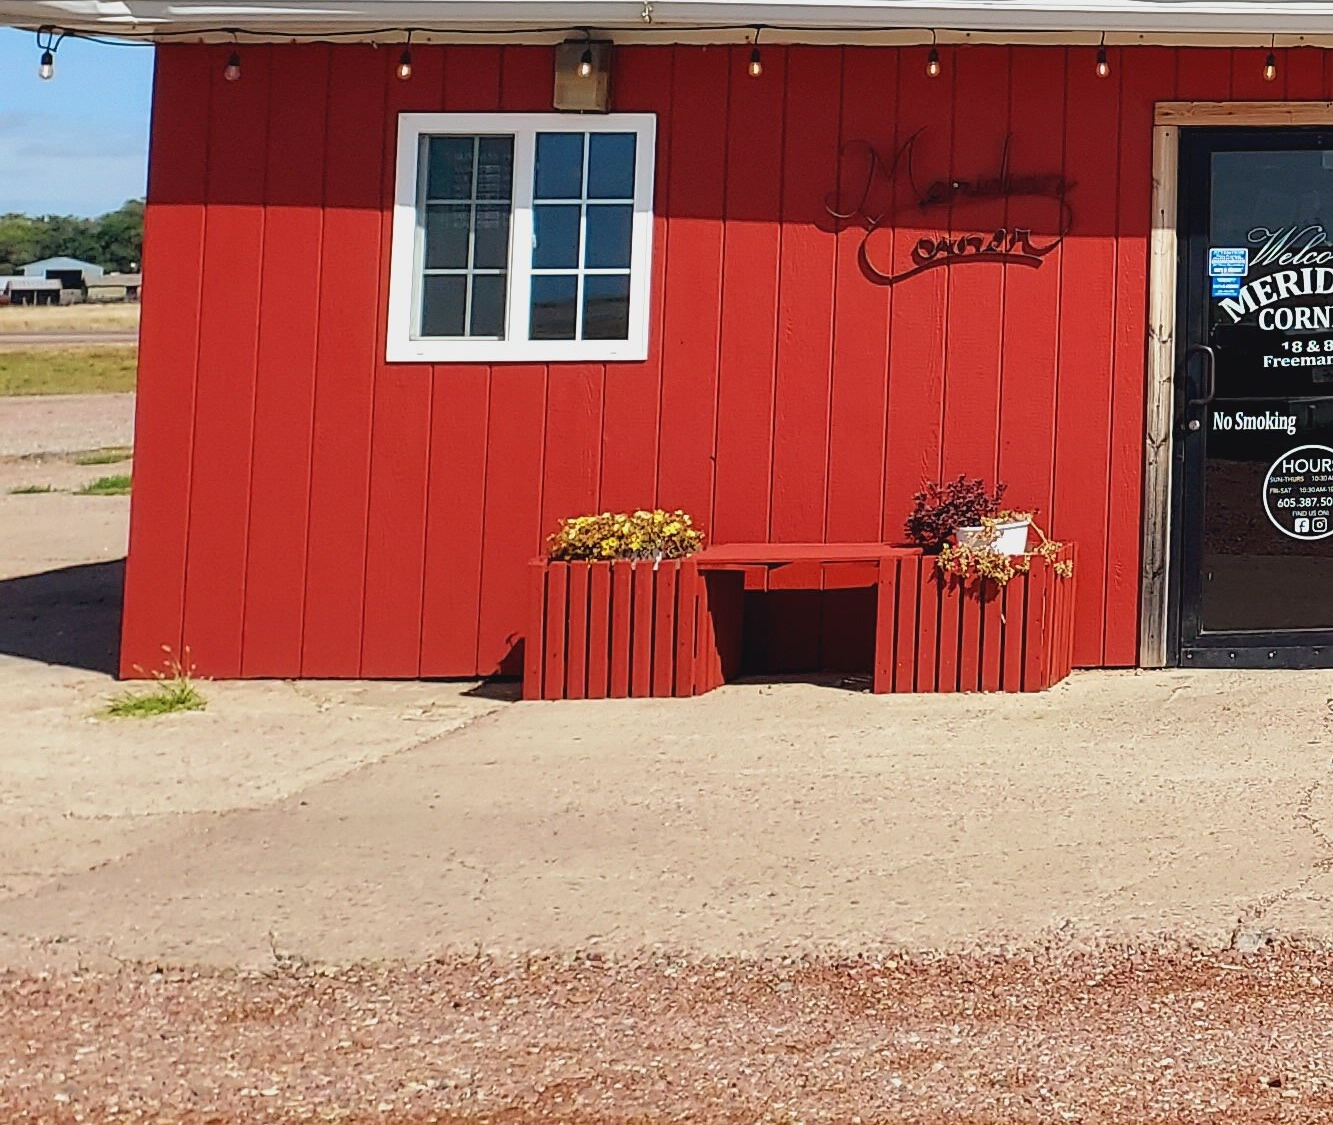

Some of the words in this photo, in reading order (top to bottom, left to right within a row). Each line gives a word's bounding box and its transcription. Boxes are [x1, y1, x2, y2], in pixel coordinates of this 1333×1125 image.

[1306, 340, 1321, 353] &
[1212, 411, 1233, 431] No
[1234, 410, 1297, 436] Smoking
